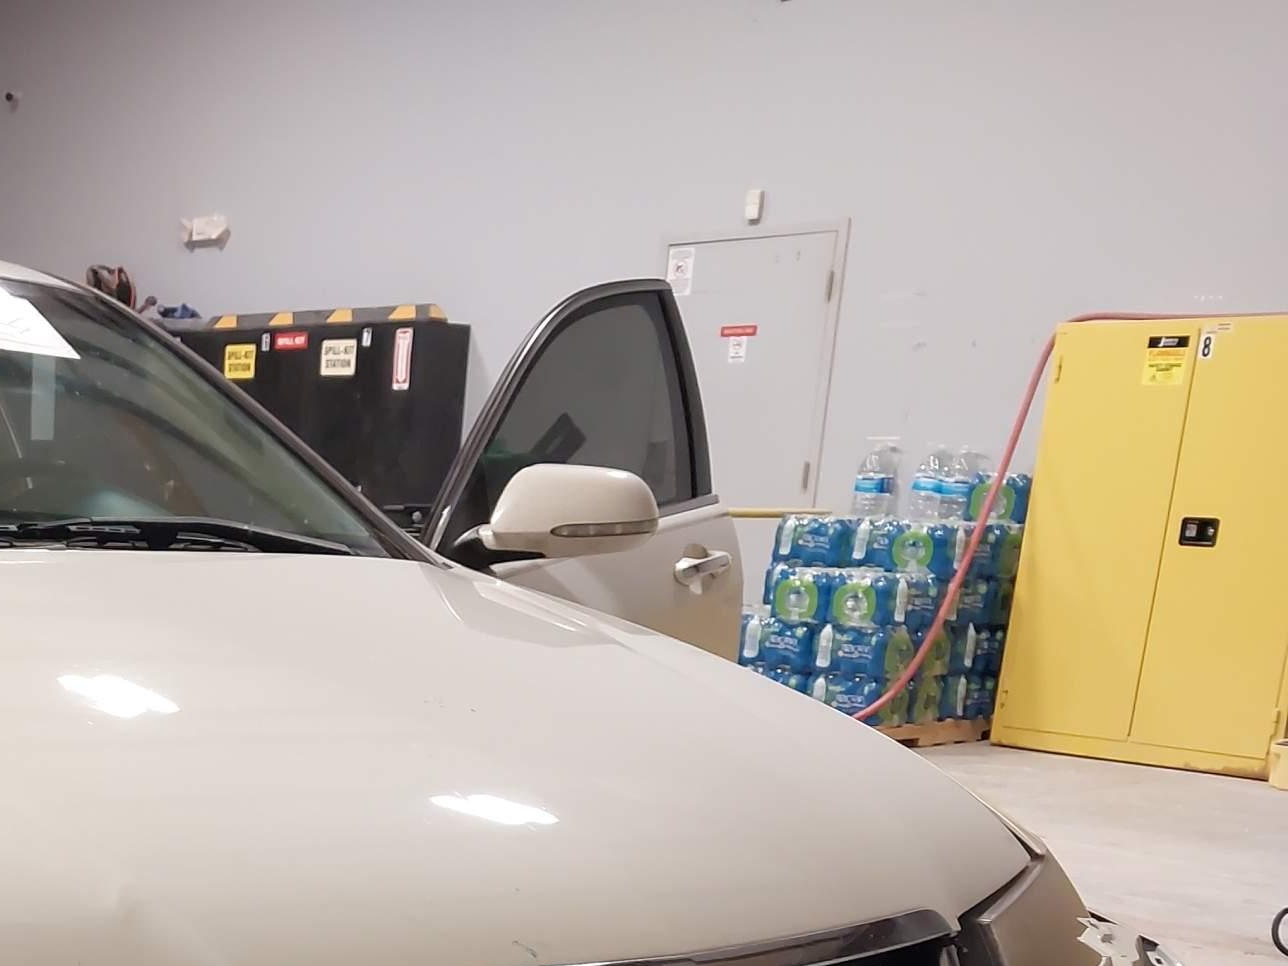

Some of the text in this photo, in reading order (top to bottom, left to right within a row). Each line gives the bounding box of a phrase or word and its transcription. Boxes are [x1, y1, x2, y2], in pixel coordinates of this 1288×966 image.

[1202, 336, 1212, 358] 8
[228, 363, 251, 373] STATION
[325, 359, 352, 369] STATION
